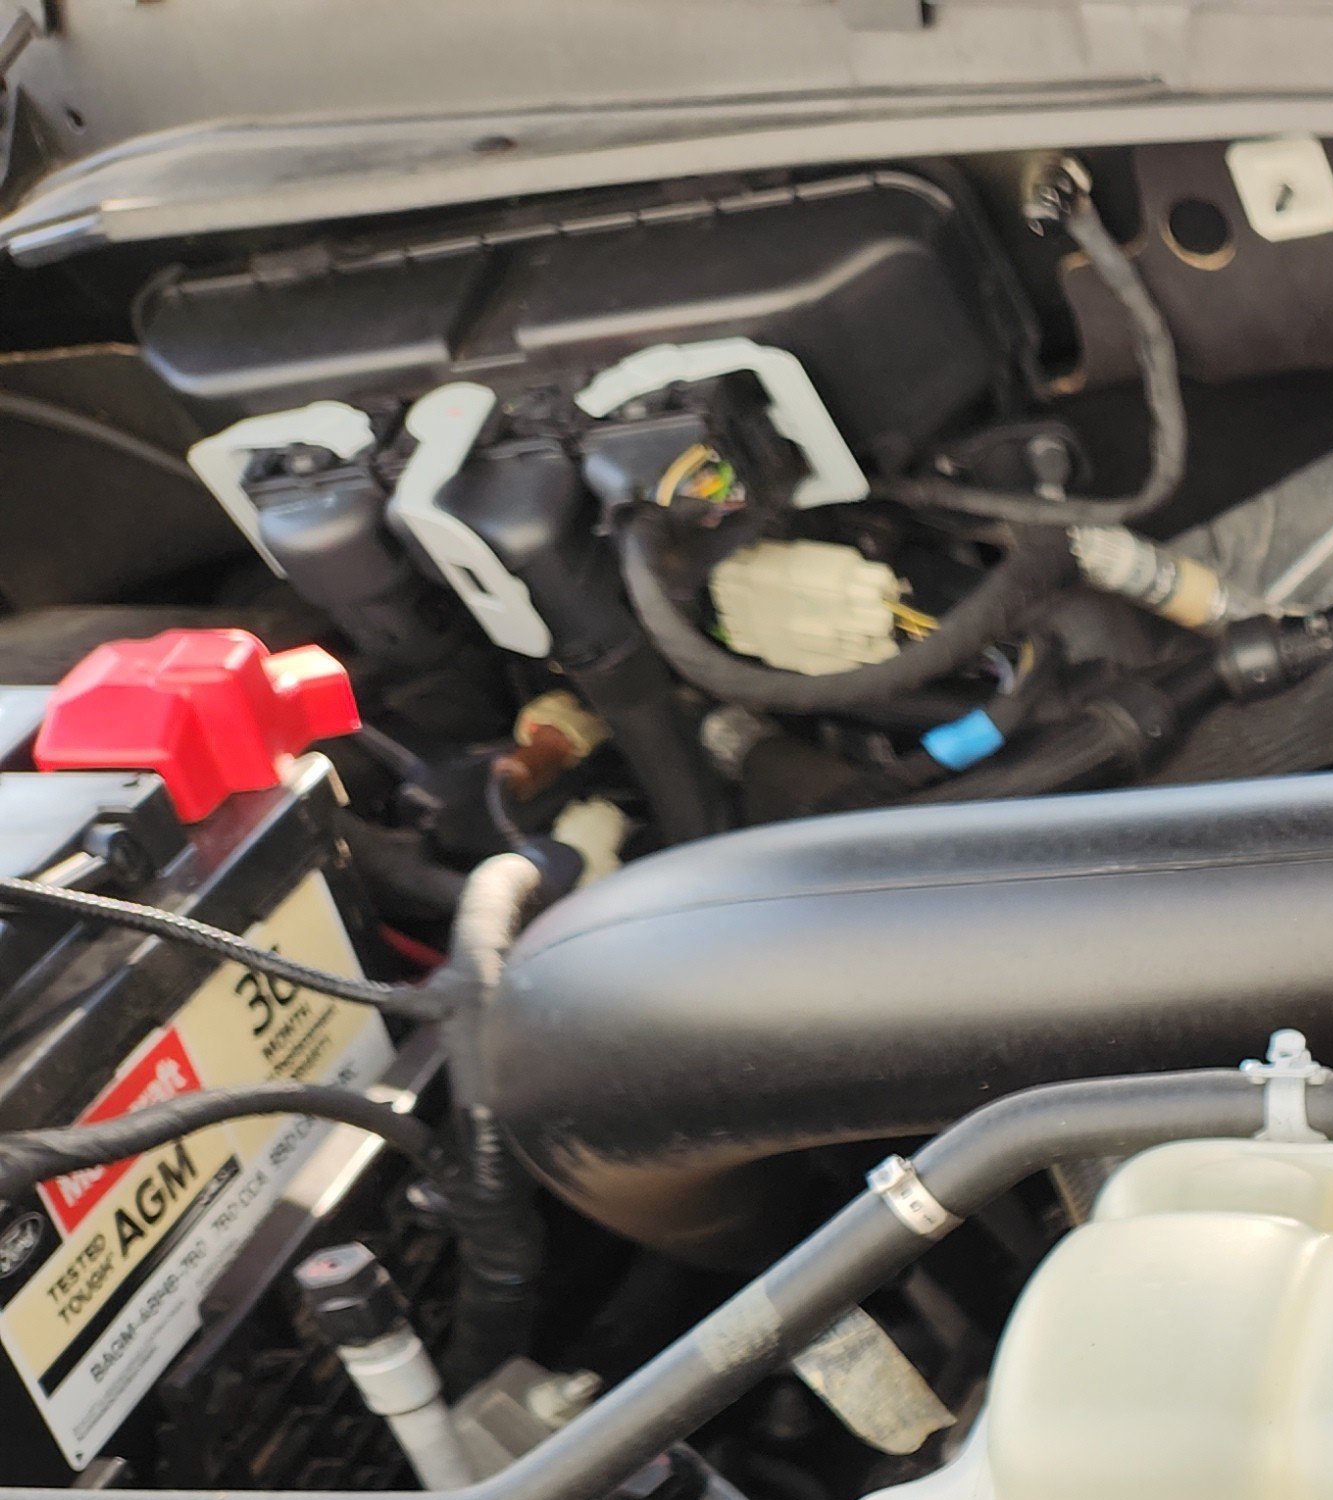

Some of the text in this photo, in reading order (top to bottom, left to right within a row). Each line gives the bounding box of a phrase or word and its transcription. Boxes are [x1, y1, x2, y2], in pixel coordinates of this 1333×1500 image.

[115, 1138, 198, 1258] AGM
[46, 1233, 108, 1304] TESTED
[56, 1253, 114, 1326] TOUGH
